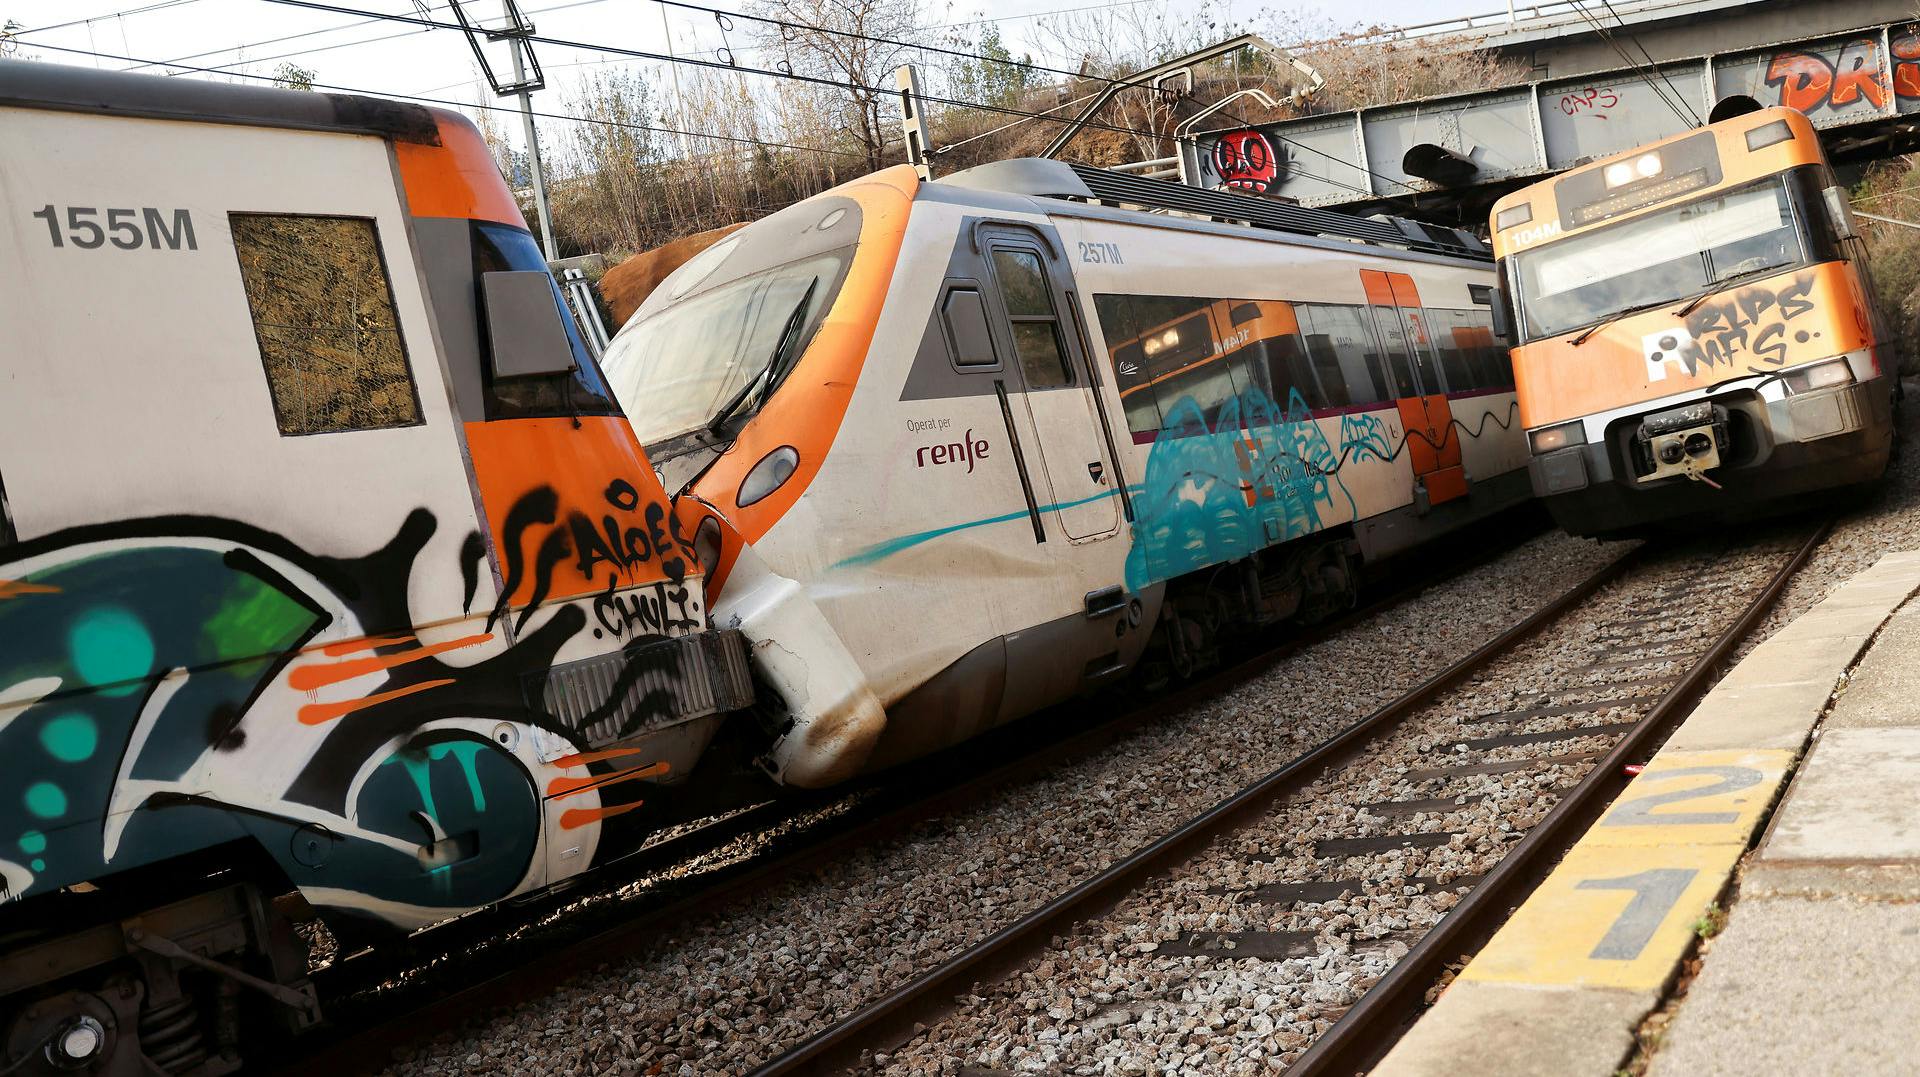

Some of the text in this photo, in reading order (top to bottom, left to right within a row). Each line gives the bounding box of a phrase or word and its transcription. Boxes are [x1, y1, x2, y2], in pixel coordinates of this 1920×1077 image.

[1560, 87, 1618, 116] CAPS
[33, 204, 198, 250] 155M
[1512, 219, 1561, 247] 104M
[1078, 241, 1124, 264] 257M
[906, 418, 951, 434] Operat per
[916, 428, 989, 474] renfe
[1601, 765, 1764, 827] 2
[1574, 868, 1699, 960] 1
